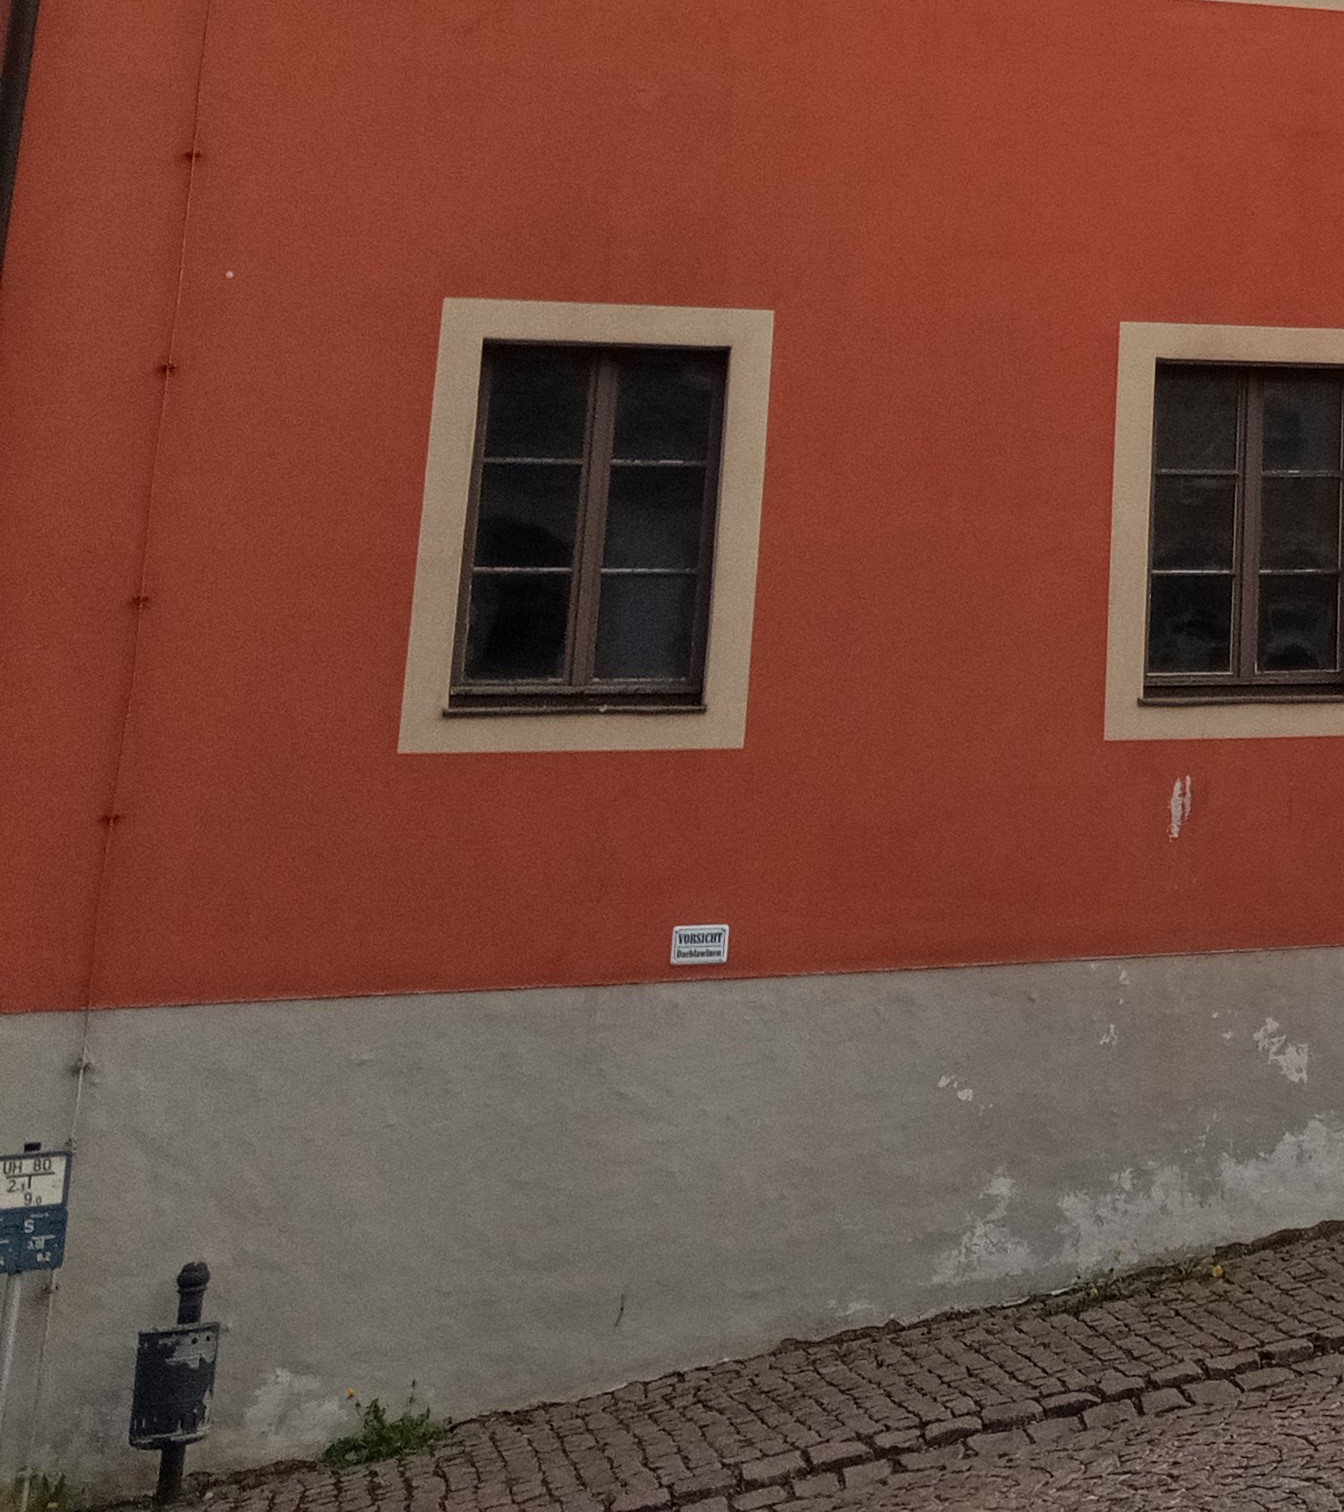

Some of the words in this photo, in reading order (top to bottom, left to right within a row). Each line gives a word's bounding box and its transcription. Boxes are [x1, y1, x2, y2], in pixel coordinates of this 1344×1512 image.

[678, 932, 723, 945] VORSICHT
[33, 1158, 52, 1172] 80
[24, 1219, 35, 1234] S
